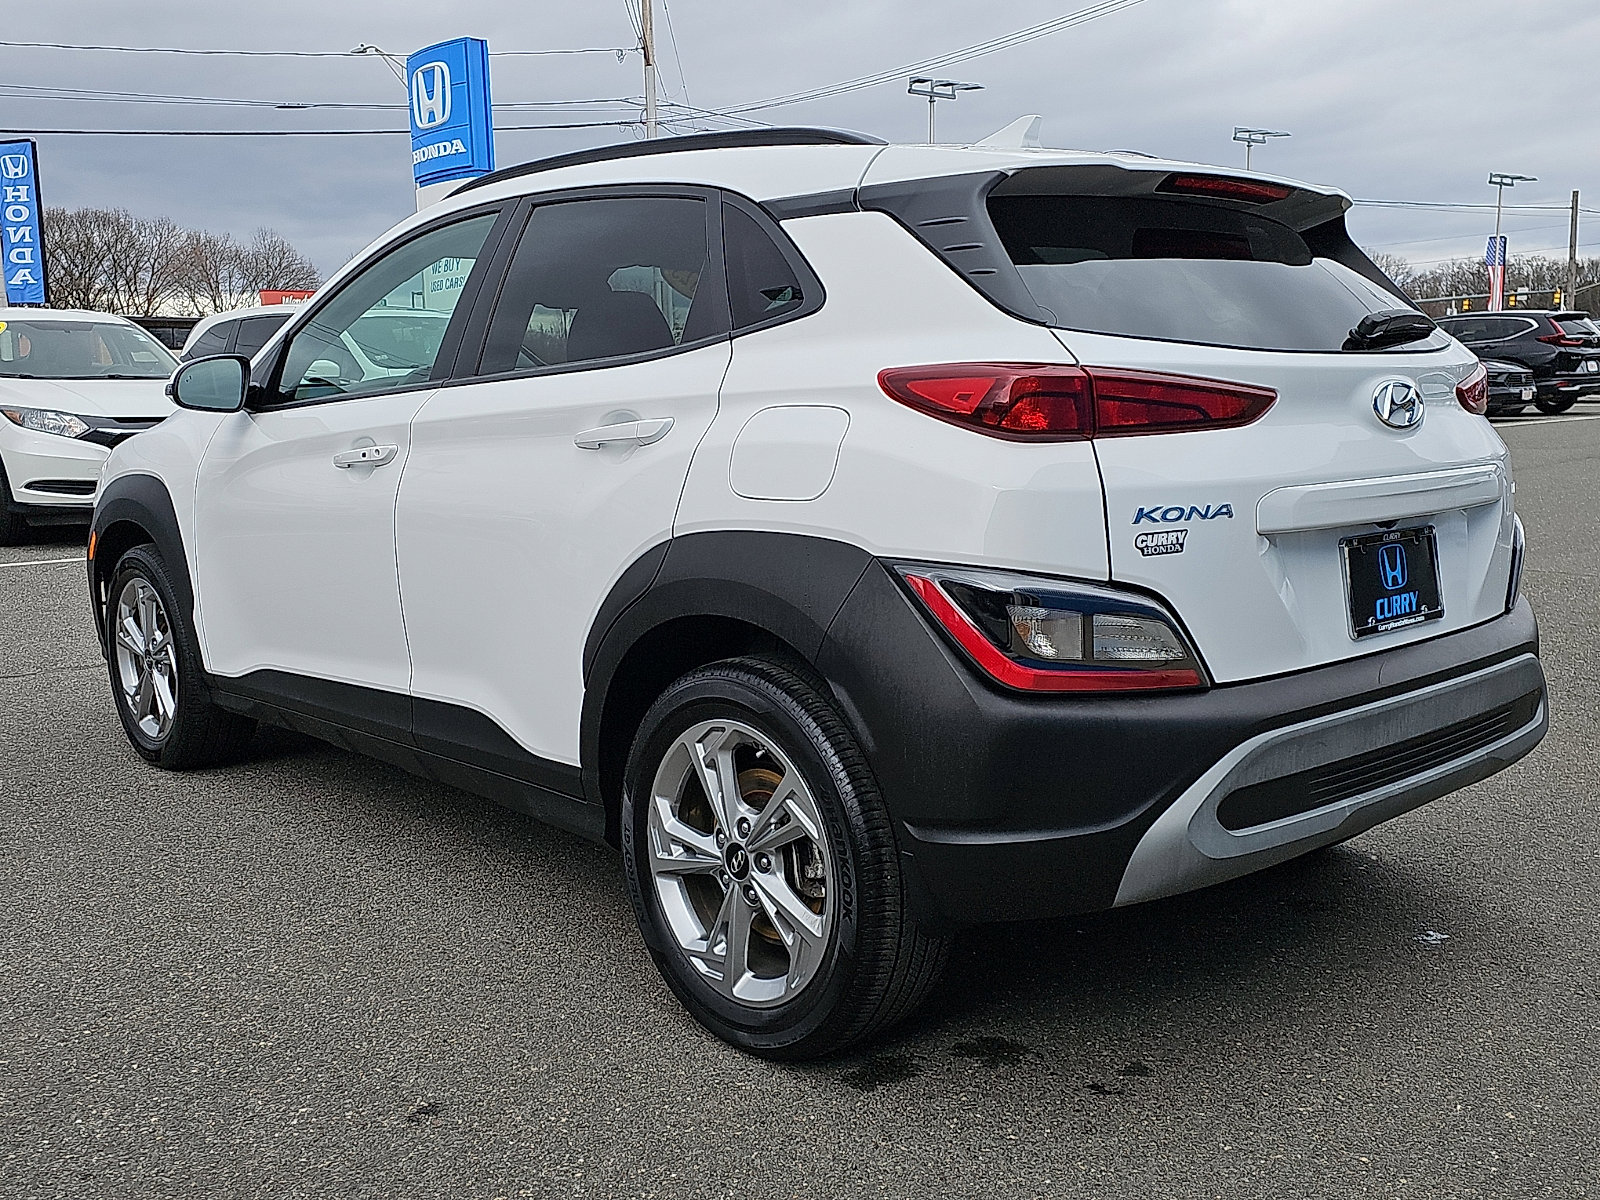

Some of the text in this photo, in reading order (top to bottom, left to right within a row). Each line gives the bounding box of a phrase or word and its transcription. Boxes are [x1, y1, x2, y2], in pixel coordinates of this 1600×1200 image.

[411, 139, 467, 165] HONDA
[431, 258, 461, 275] WE BUY
[430, 279, 444, 293] USED
[1131, 503, 1234, 524] KONA
[1136, 530, 1188, 549] CURRY
[1143, 543, 1183, 555] HONDA
[1376, 590, 1419, 620] CURRY
